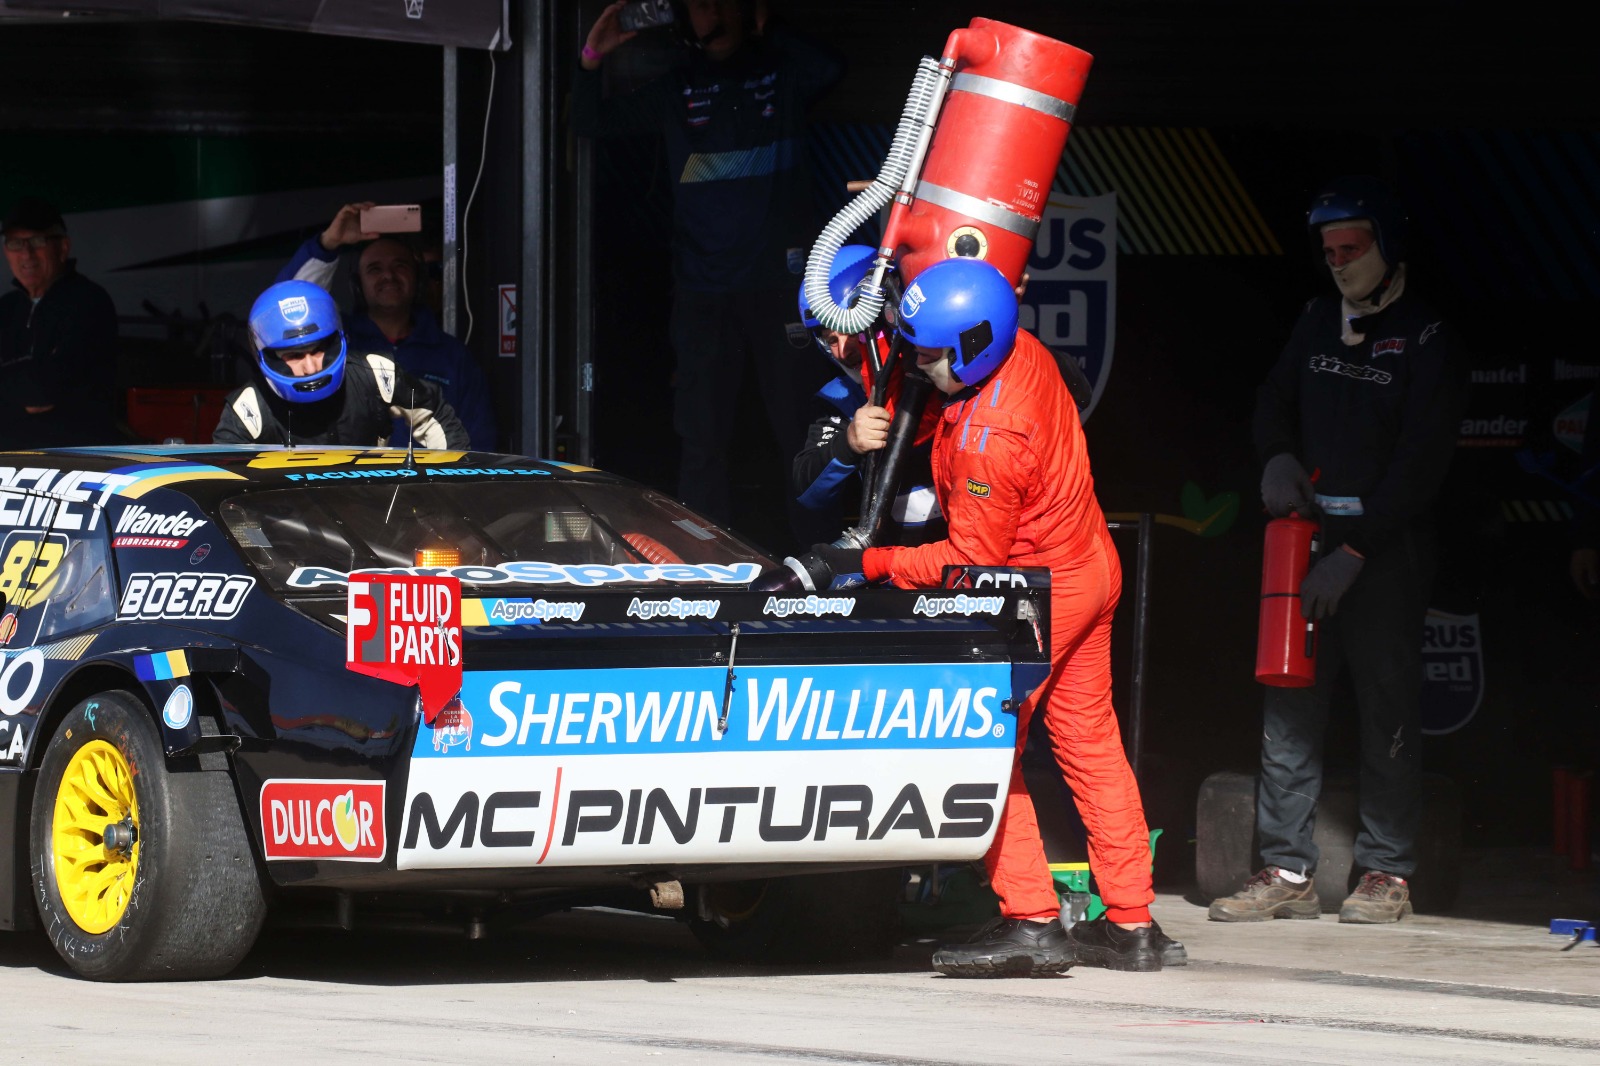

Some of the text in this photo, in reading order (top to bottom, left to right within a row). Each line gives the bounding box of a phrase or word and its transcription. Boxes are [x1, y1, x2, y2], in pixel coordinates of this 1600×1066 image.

[284, 469, 418, 482] FACUNDO
[967, 482, 989, 495] OMP
[115, 504, 208, 537] Wander
[116, 537, 180, 548] LUBRICANTES
[286, 561, 762, 587] AroSpray
[117, 574, 255, 619] BOERO
[390, 582, 452, 623] FLUID
[627, 597, 720, 620] AgroSpray
[763, 595, 856, 618] AgroSpray
[913, 594, 1005, 617] AgroSpray
[491, 598, 585, 622] AgroSpray
[390, 626, 460, 666] PARTS
[1423, 655, 1473, 681] ed
[480, 678, 998, 747] SHERWIN WILLIAMS
[270, 790, 377, 851] DULCOR
[403, 783, 999, 850] MC PINTURAS
